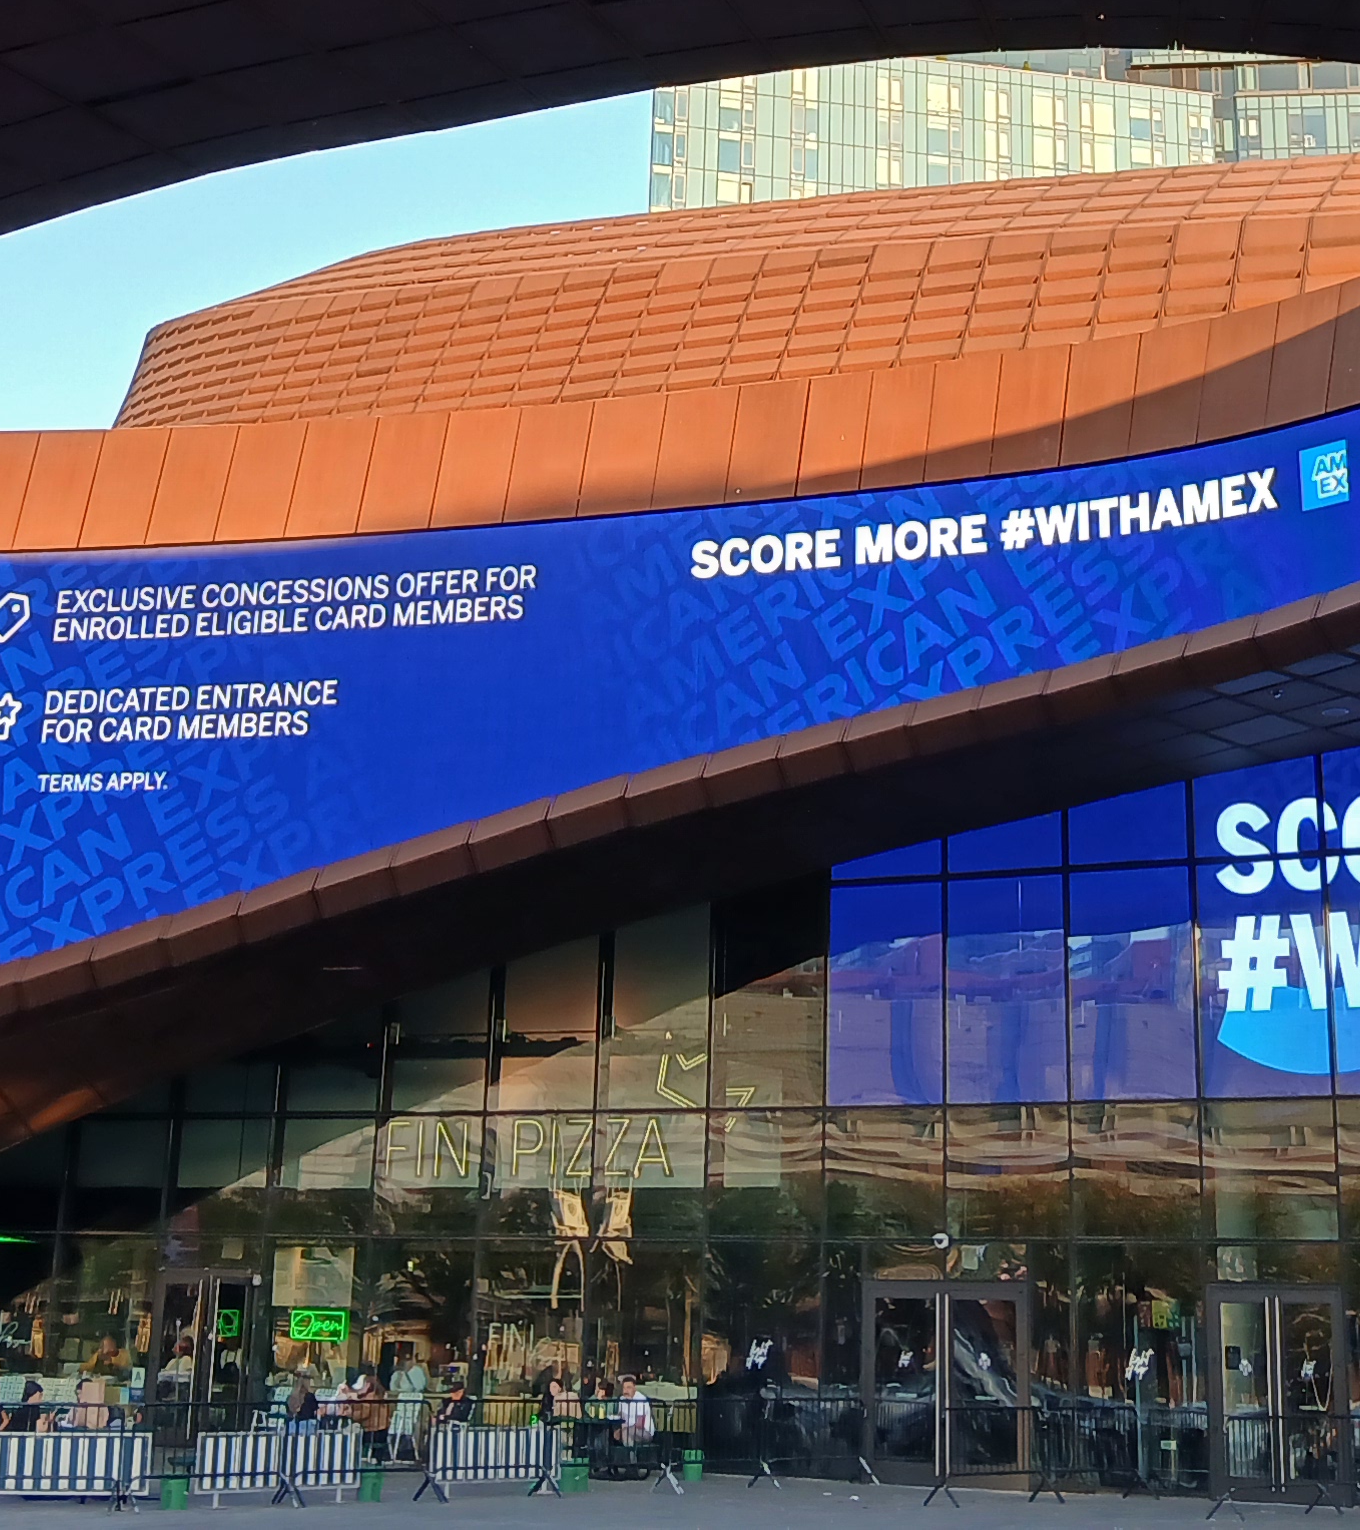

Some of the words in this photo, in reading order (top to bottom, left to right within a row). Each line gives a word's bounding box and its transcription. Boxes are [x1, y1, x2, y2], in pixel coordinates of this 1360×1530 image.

[691, 528, 841, 580] SCORE
[855, 514, 988, 566] MORE
[1000, 467, 1278, 552] #WITHAMEX
[56, 584, 196, 615] EXCLUSIVE
[201, 575, 391, 609] CONCESSIONS
[396, 570, 479, 599] OFFER
[484, 564, 537, 592] FOR
[52, 612, 190, 643] ENROLLED
[195, 606, 309, 636] ELIGIBLE
[314, 602, 388, 632] CARD
[392, 595, 524, 627] MEMBERS
[44, 686, 190, 715] DEDICATED
[196, 679, 338, 711] ENTRANCE
[41, 717, 93, 744] FOR
[98, 715, 172, 743] CARD
[177, 710, 310, 740] MEMBERS
[38, 773, 103, 792] TERMS
[105, 771, 168, 791] APPLY.
[511, 1117, 674, 1177] PIZZA
[293, 1312, 342, 1338] Open
